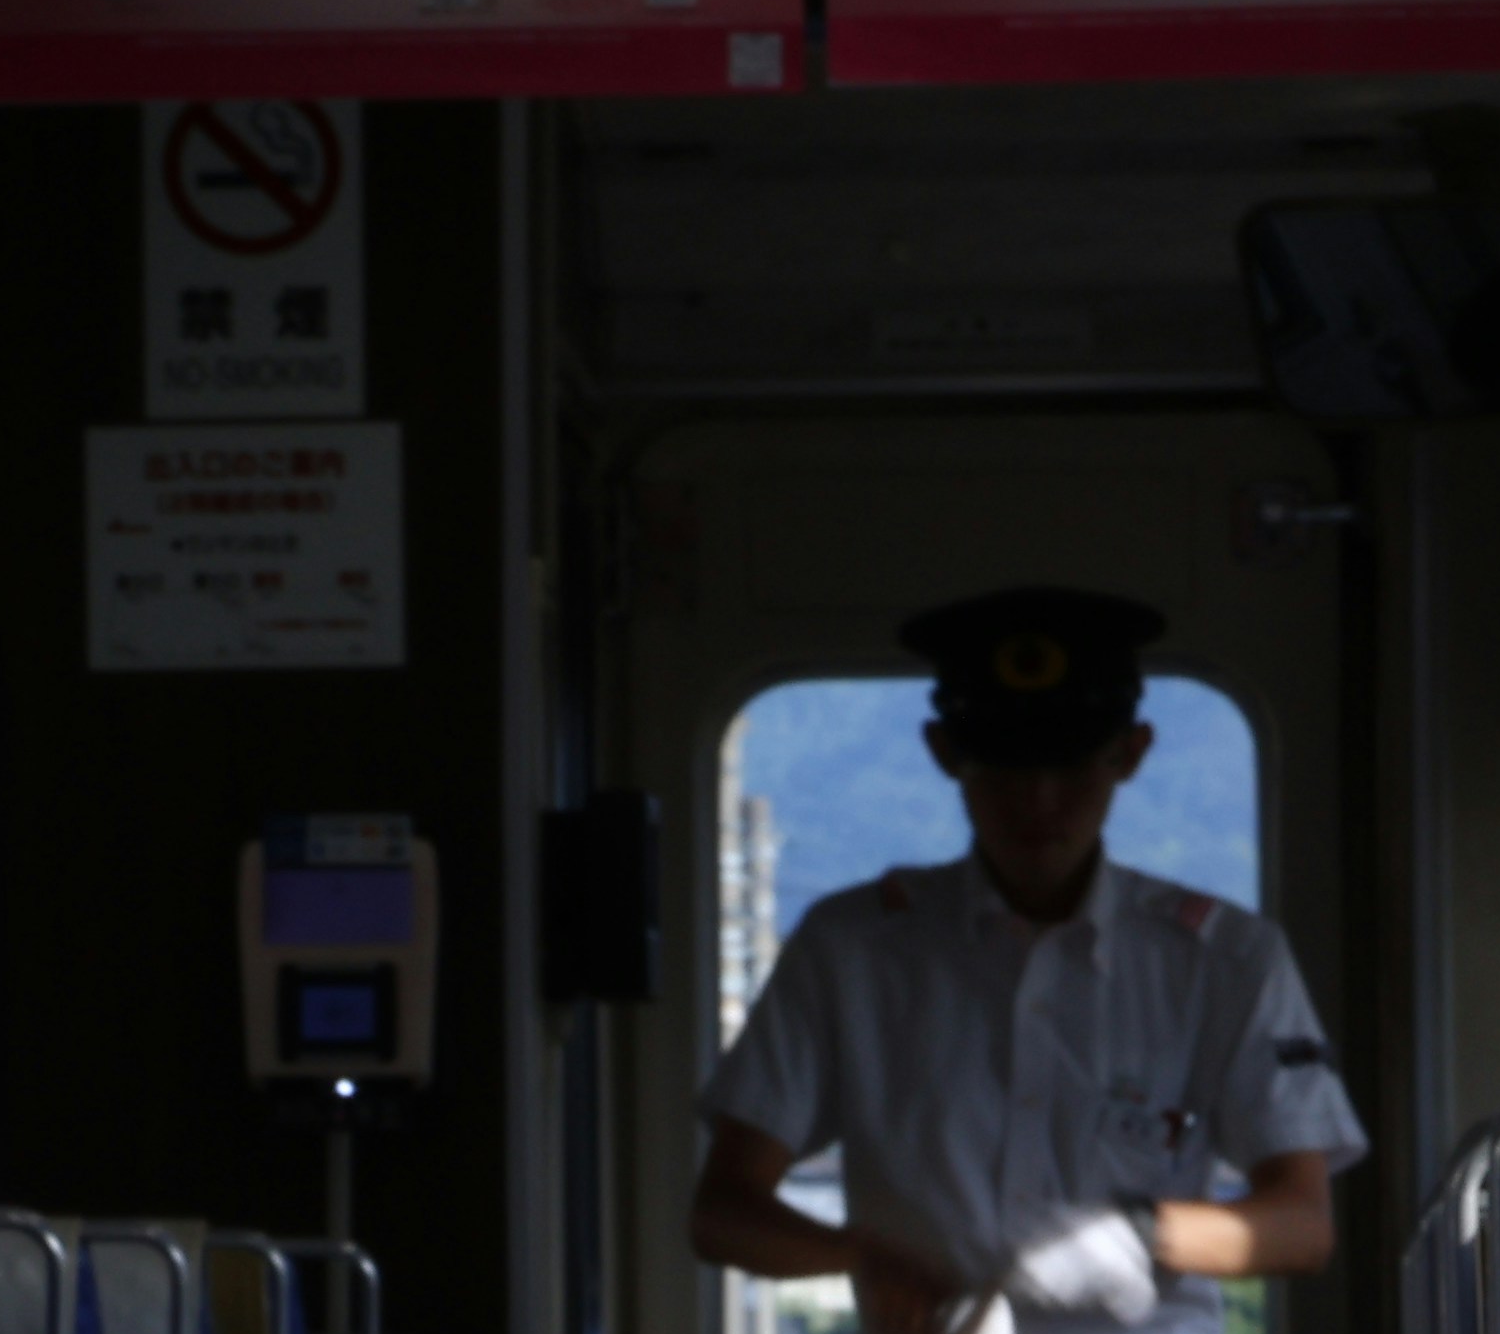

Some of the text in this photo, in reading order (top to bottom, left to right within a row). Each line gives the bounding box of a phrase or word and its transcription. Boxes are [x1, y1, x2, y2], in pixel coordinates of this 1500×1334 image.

[178, 286, 329, 343] 禁煙
[164, 356, 344, 389] NO SMOKING
[144, 448, 347, 482] 出入口のご案内
